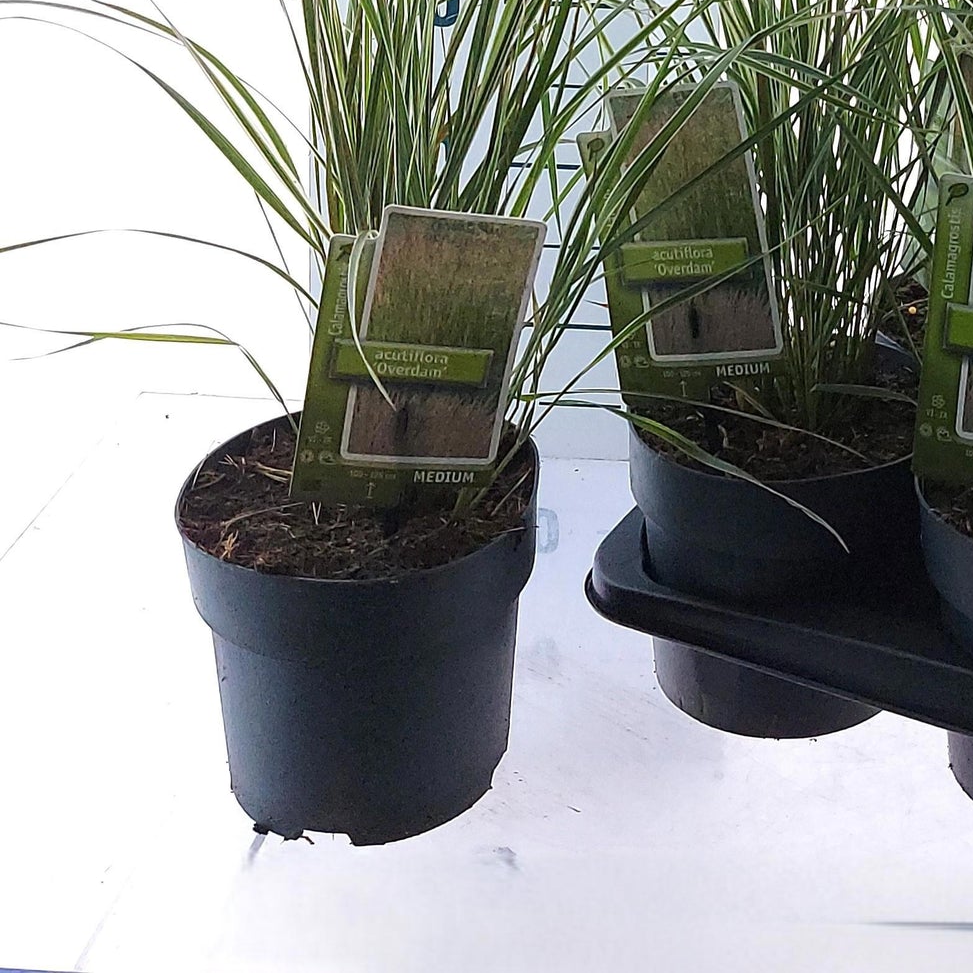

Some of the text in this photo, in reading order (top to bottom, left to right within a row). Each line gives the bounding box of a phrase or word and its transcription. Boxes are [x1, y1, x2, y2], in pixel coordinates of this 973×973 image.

[652, 246, 714, 261] acutiflora
[374, 349, 449, 365] acutiflora
[716, 362, 771, 377] MEDIUM
[413, 470, 475, 483] MEDIUM
